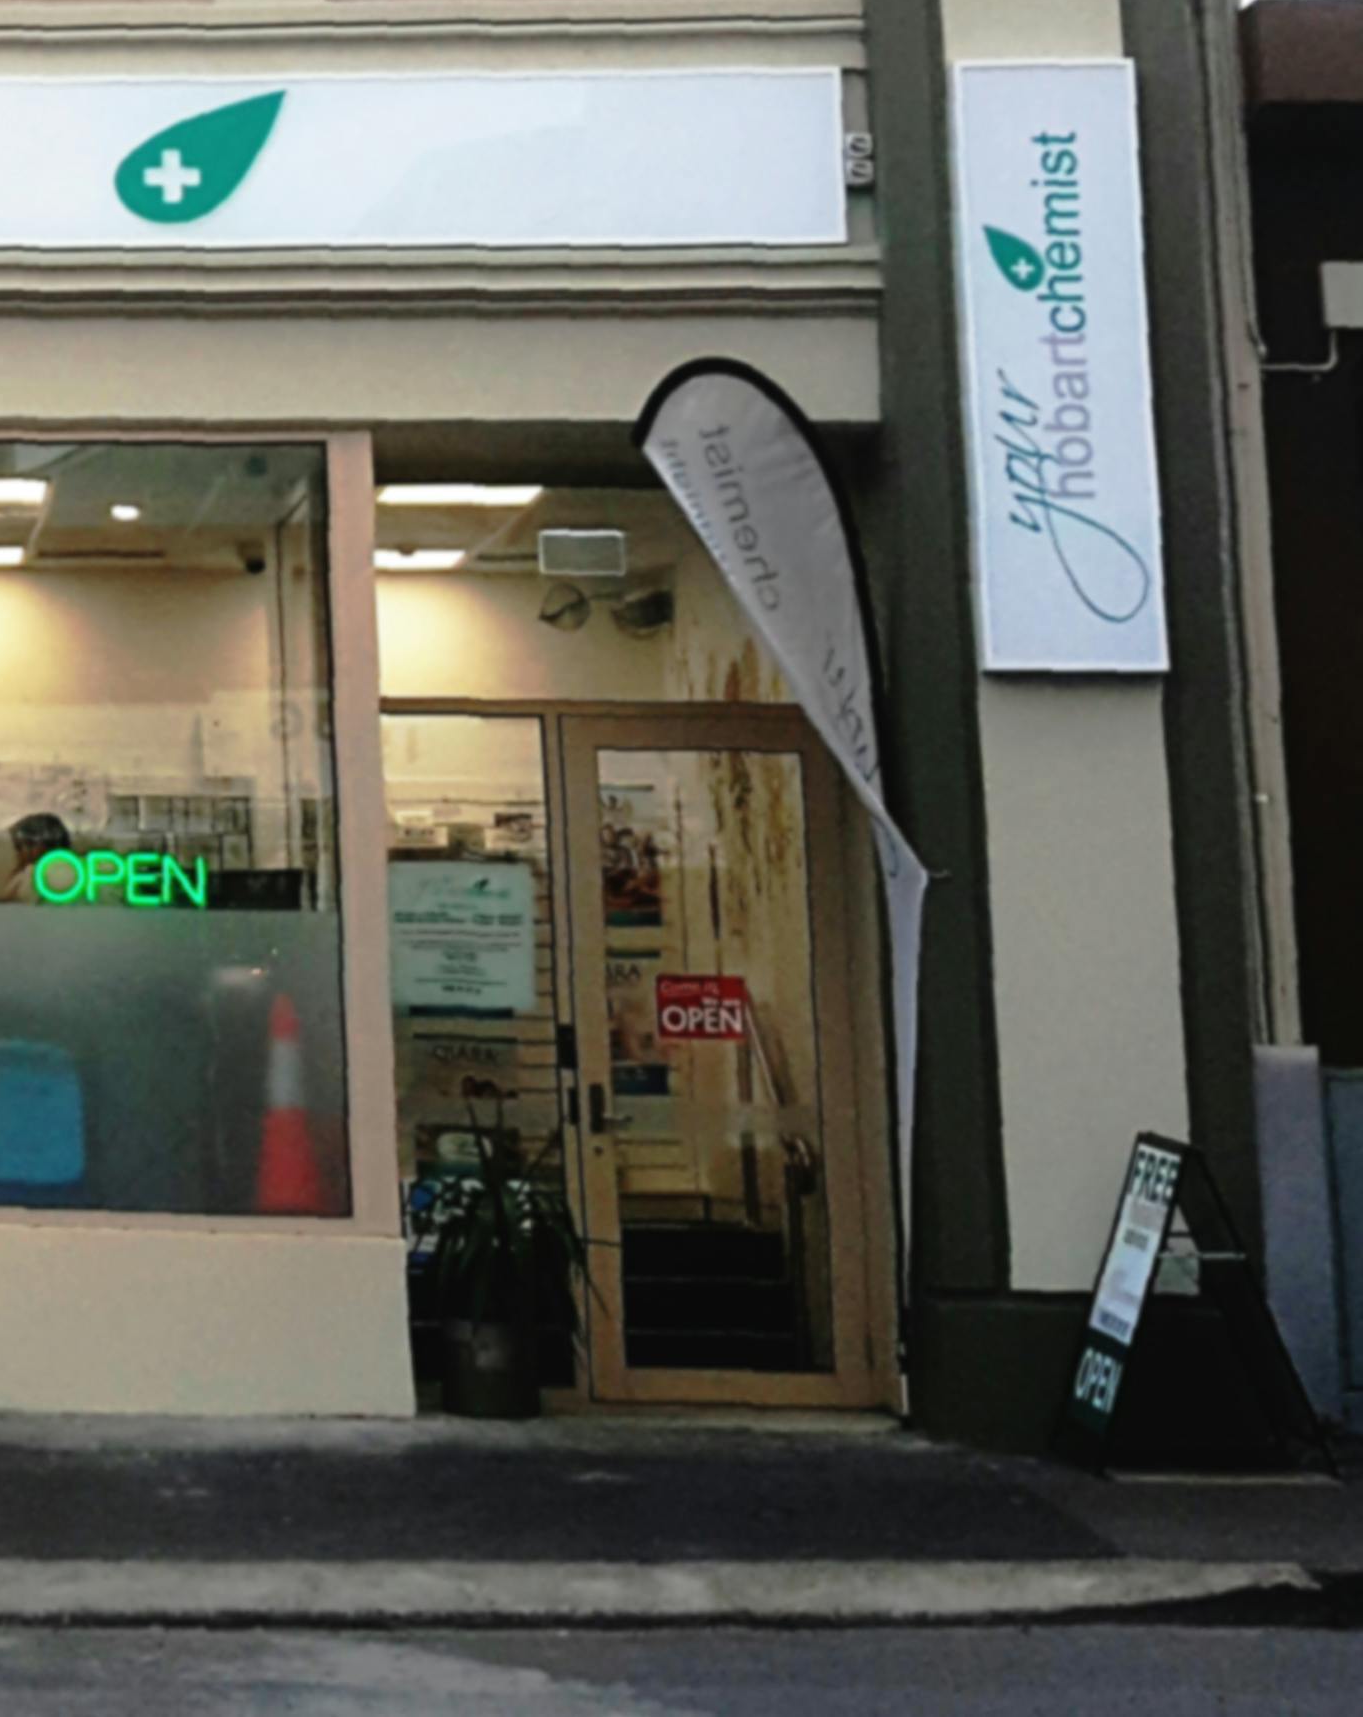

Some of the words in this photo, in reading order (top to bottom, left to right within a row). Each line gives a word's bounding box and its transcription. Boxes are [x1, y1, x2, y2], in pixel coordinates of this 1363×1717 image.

[995, 369, 1150, 623] your
[33, 847, 207, 908] OPEN
[662, 1005, 743, 1033] OPEN
